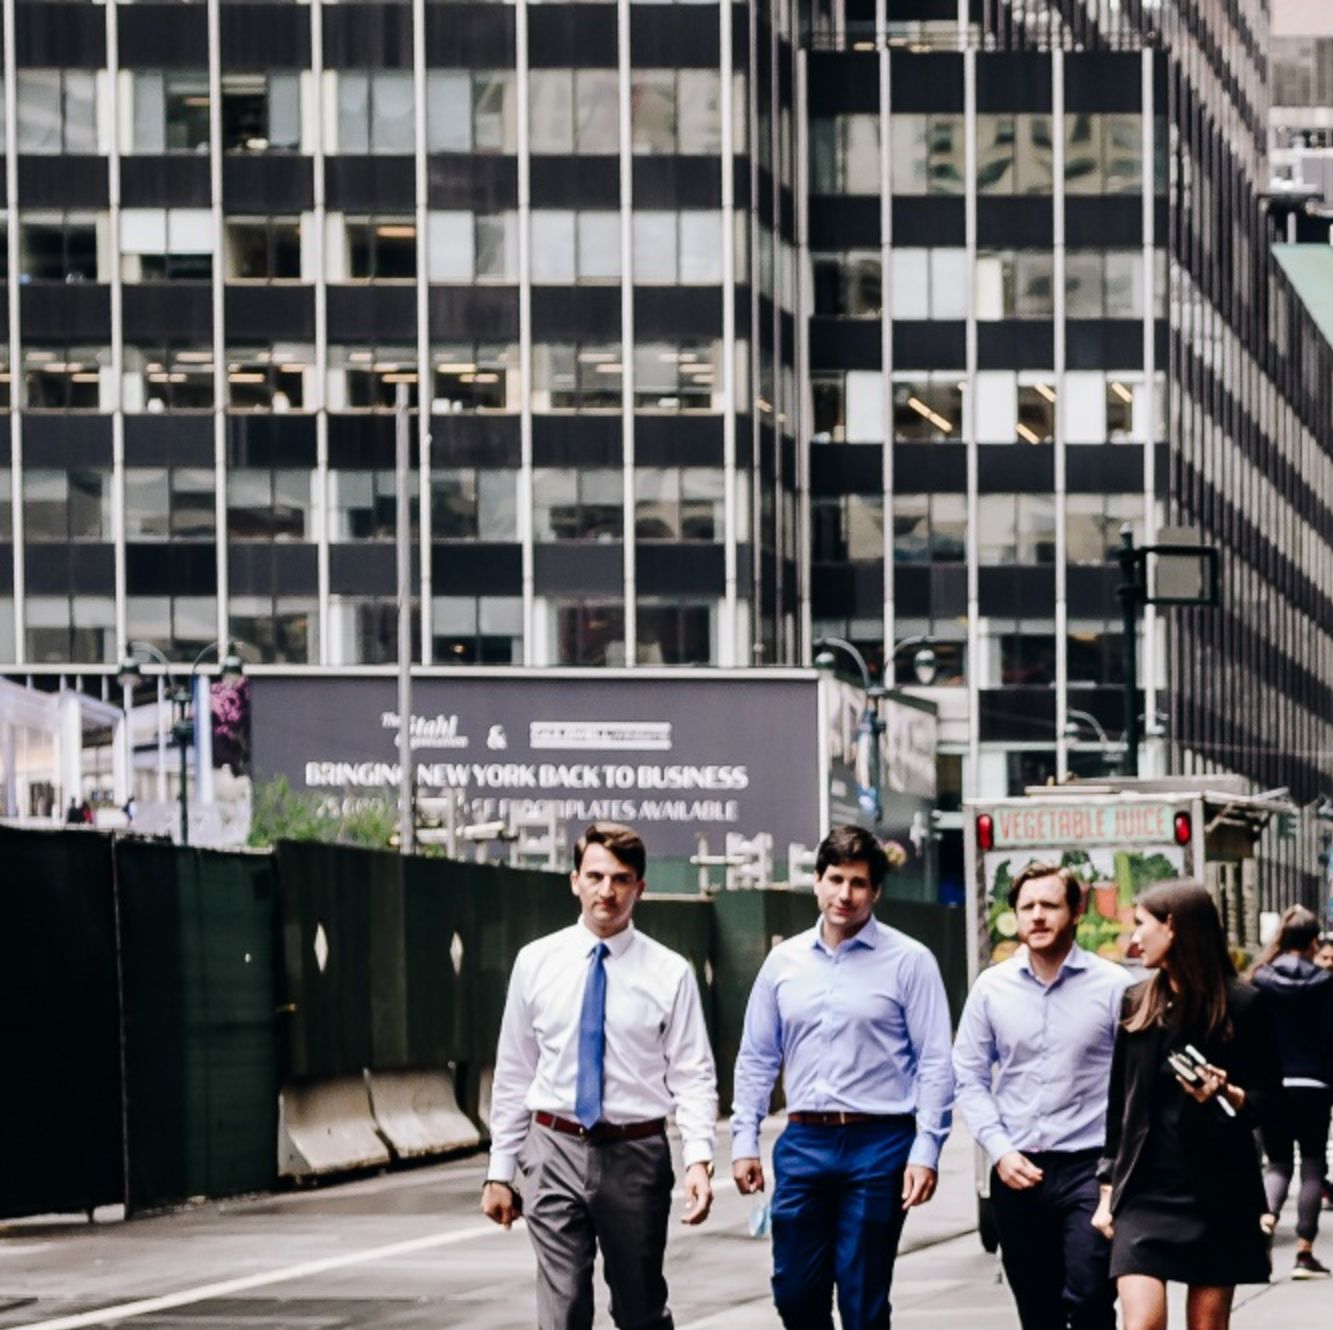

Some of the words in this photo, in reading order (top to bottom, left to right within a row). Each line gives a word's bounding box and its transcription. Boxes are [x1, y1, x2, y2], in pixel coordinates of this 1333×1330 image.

[487, 724, 508, 750] &
[305, 761, 411, 786] BRINGIN
[417, 763, 470, 787] NEW
[472, 763, 536, 788] YORK
[539, 764, 600, 788] BACK
[602, 764, 635, 788] TO
[637, 765, 749, 789] BUSINESS
[639, 800, 739, 821] AVAILABLE
[1000, 808, 1105, 840] VEGETABLE
[1115, 806, 1165, 836] JUICE
